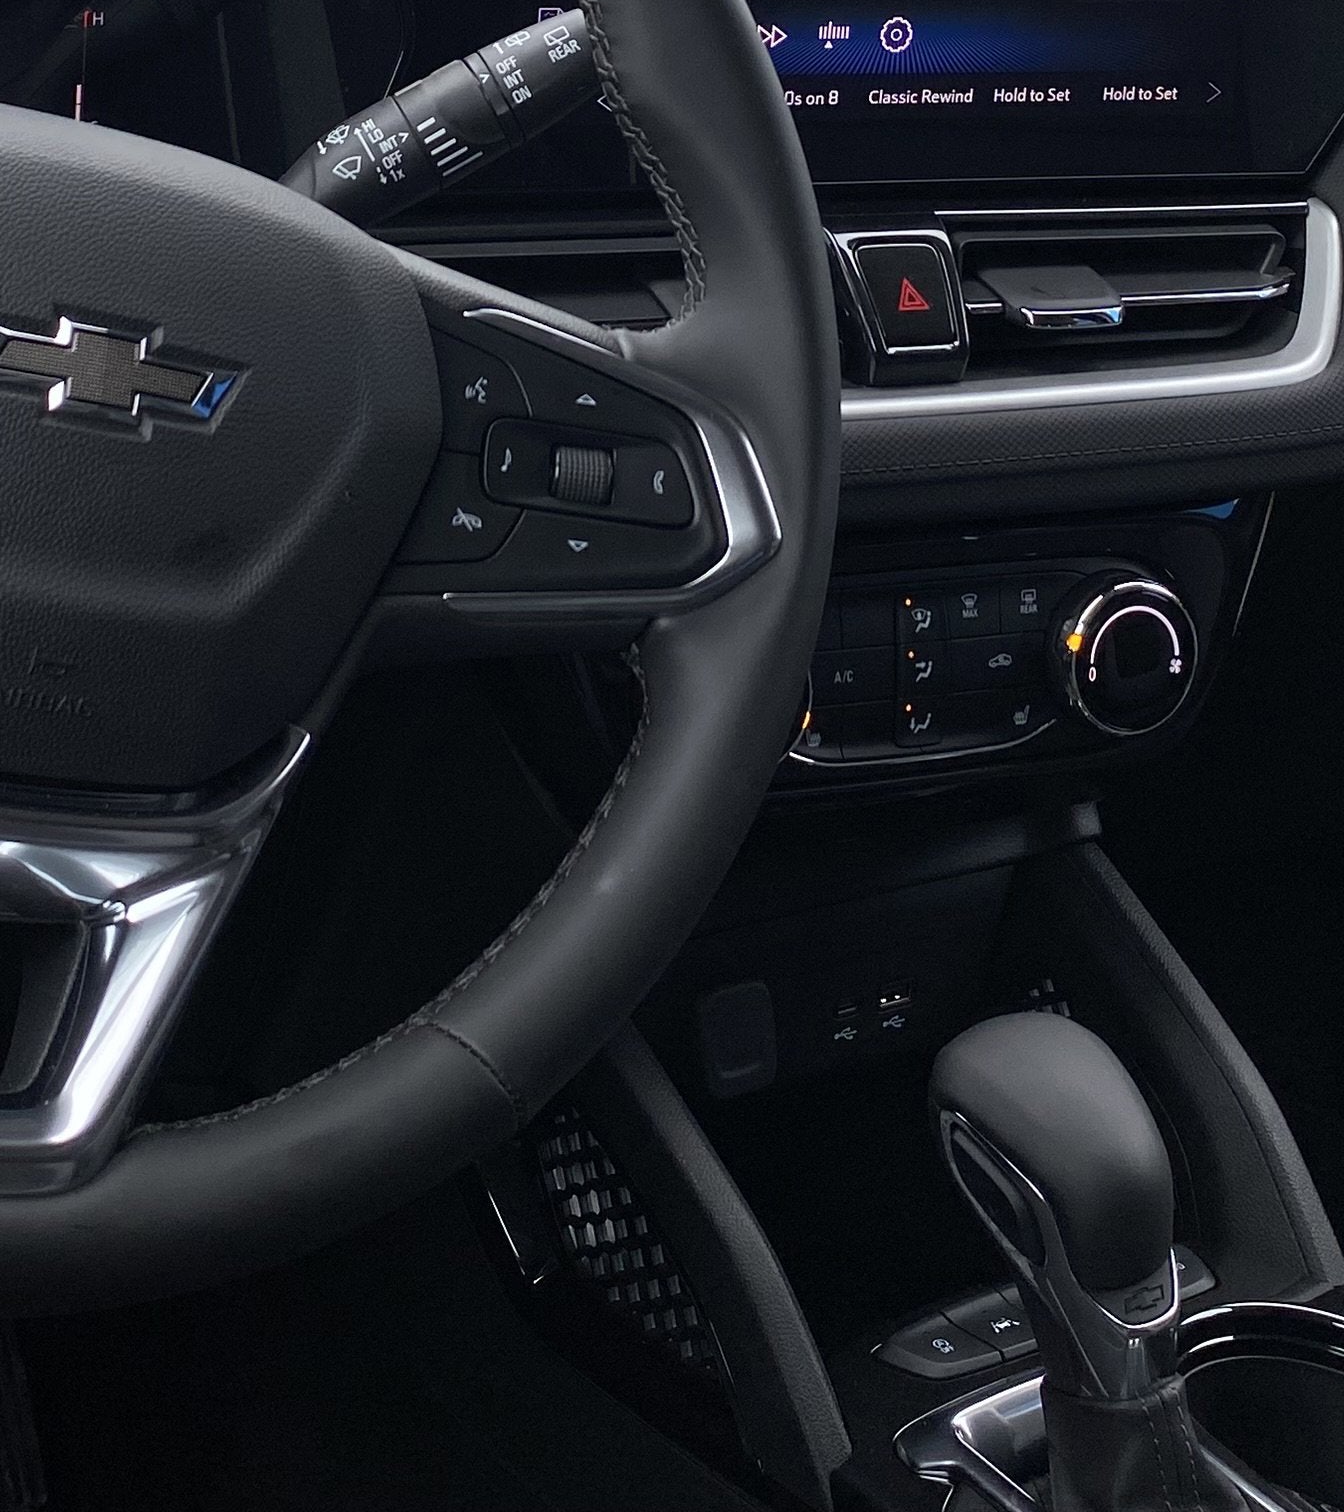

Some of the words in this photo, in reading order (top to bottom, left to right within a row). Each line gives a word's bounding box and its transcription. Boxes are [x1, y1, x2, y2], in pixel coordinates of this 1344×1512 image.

[92, 12, 104, 26] H
[548, 39, 581, 63] REAR
[495, 55, 517, 74] OFF
[503, 68, 524, 89] INT
[512, 85, 532, 104] ON
[806, 93, 824, 105] on
[828, 90, 839, 105] 8
[868, 89, 918, 105] Classic
[921, 88, 974, 104] Rewind
[993, 87, 1027, 103] Hold
[1029, 89, 1045, 102] to
[1047, 88, 1071, 102] Set
[1103, 86, 1136, 101] Hold
[1138, 88, 1153, 101] to
[1155, 86, 1178, 101] Set
[361, 118, 376, 133] HI
[367, 128, 384, 144] LO
[378, 134, 398, 154] INT
[382, 149, 403, 170] OFF
[389, 168, 406, 182] 1x
[962, 609, 979, 618] MAX
[1019, 604, 1038, 614] REAR
[833, 670, 854, 683] A/C
